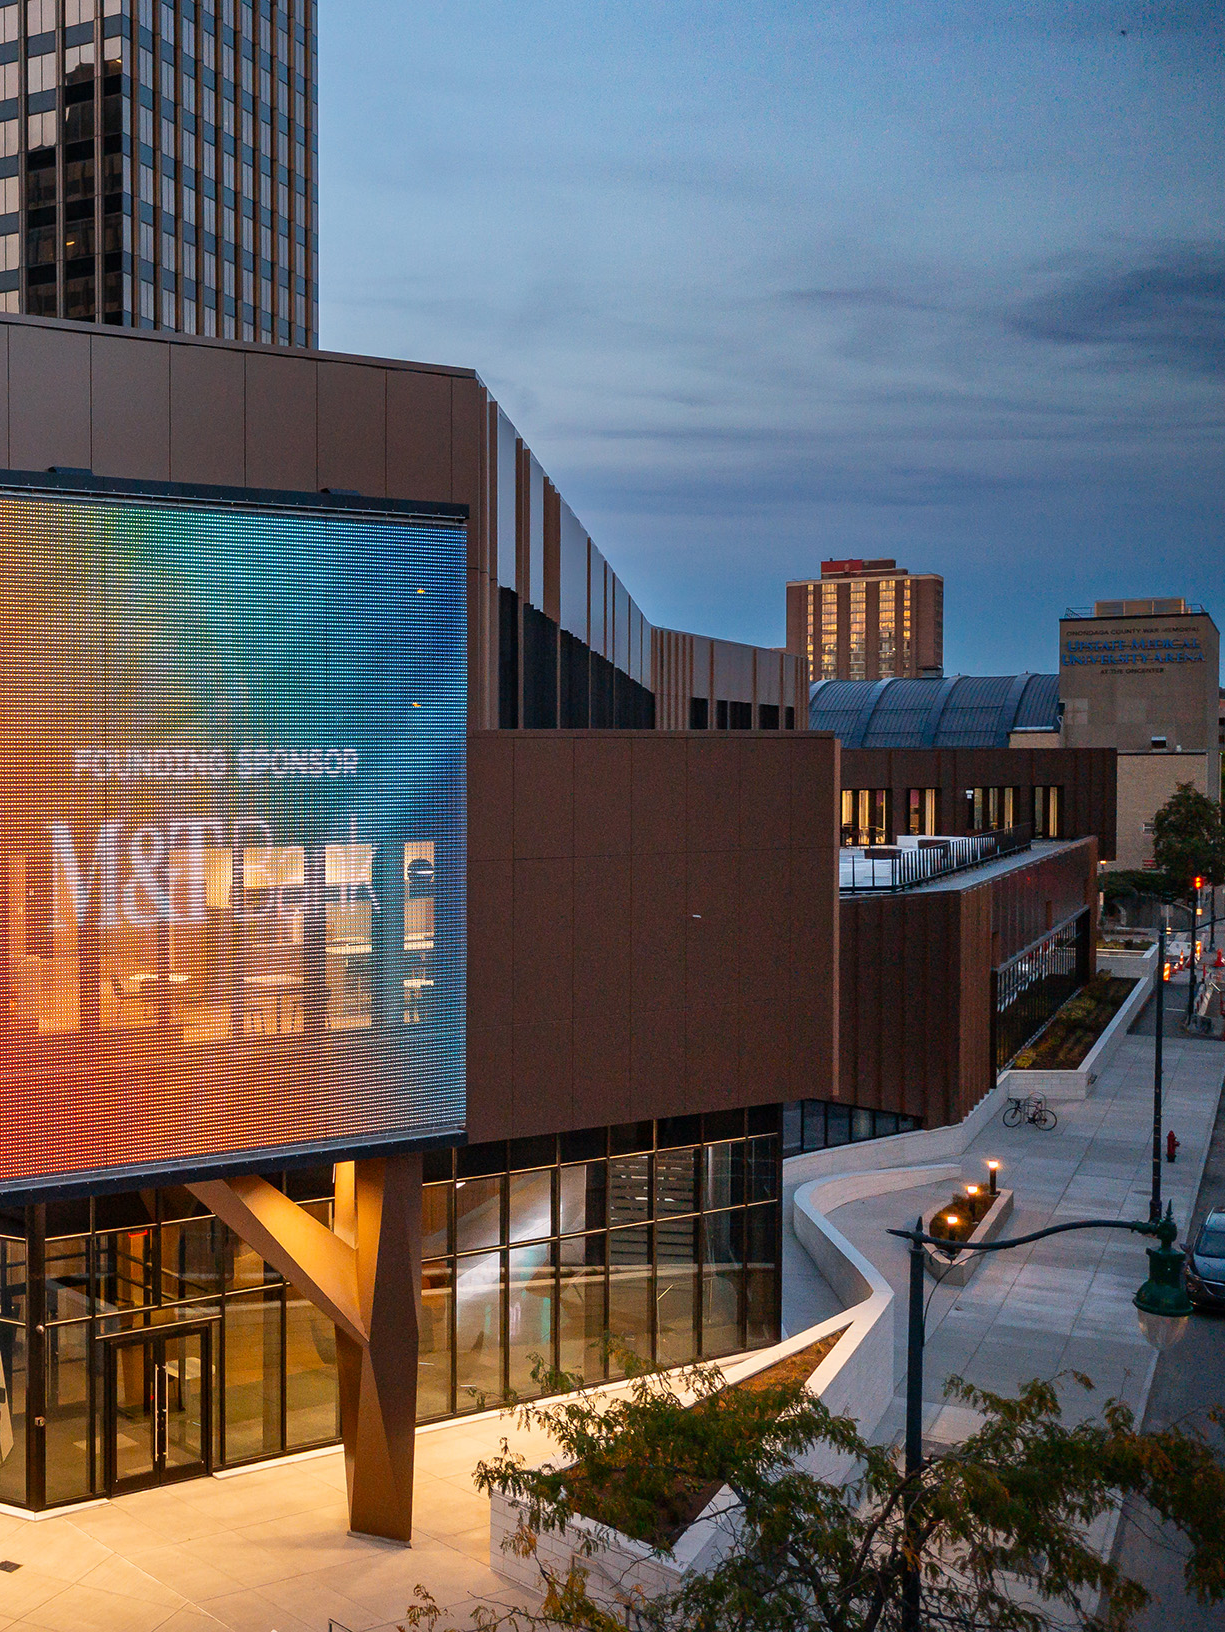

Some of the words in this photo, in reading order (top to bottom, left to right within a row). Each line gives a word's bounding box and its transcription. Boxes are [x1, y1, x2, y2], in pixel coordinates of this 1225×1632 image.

[1068, 640, 1126, 652] UPSTATE
[1131, 638, 1201, 650] MEDICAL
[1061, 652, 1150, 666] UNIVERSITY
[1152, 651, 1206, 663] ARENA
[74, 748, 228, 779] FOUNDING
[236, 747, 359, 778] SPONSOR
[46, 818, 223, 931] M&T
